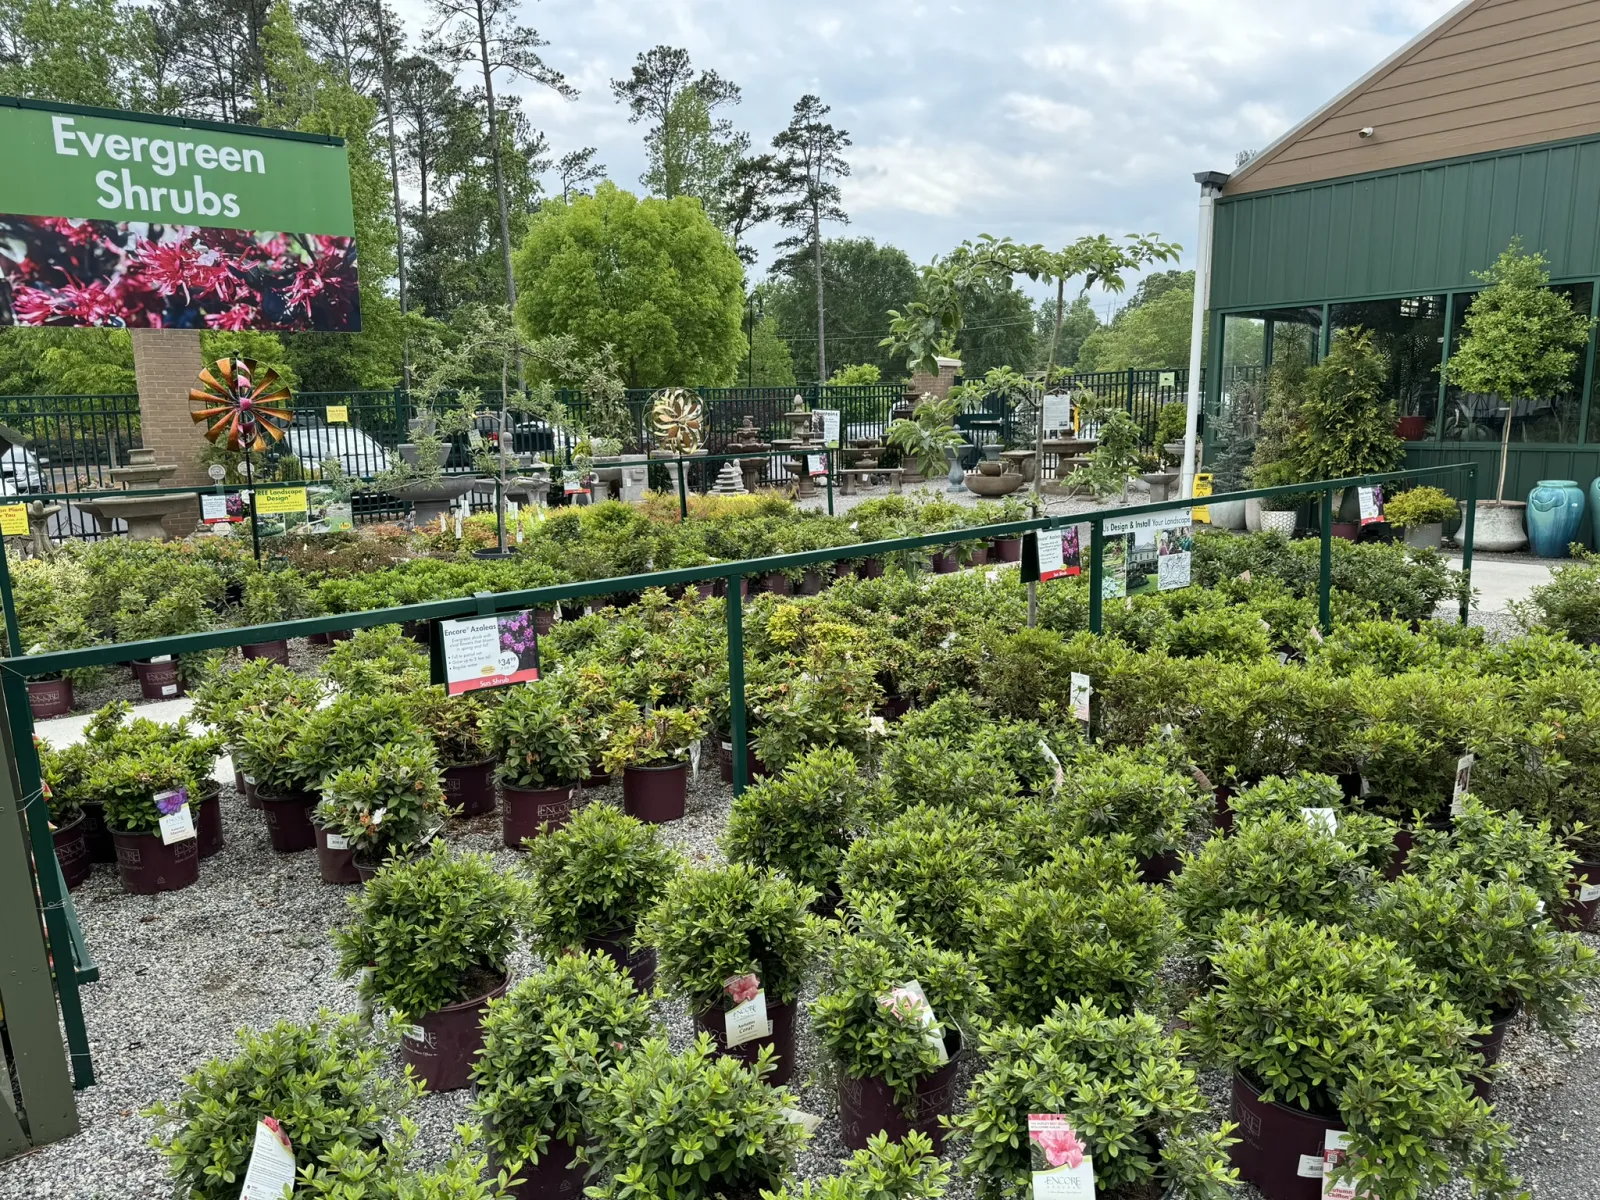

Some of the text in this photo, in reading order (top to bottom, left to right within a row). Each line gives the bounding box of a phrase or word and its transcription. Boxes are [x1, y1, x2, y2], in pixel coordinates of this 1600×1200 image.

[51, 115, 266, 176] Evergreen
[95, 168, 241, 218] Shrubs
[269, 488, 303, 496] Landscape
[1110, 522, 1129, 533] Design
[1129, 520, 1134, 529] &
[1135, 518, 1151, 529] Install
[1151, 518, 1164, 527] Your
[1164, 515, 1191, 527] Landscape
[470, 623, 497, 633] Azaleas
[492, 676, 510, 685] Shrub
[1044, 1176, 1082, 1189] ENCORE
